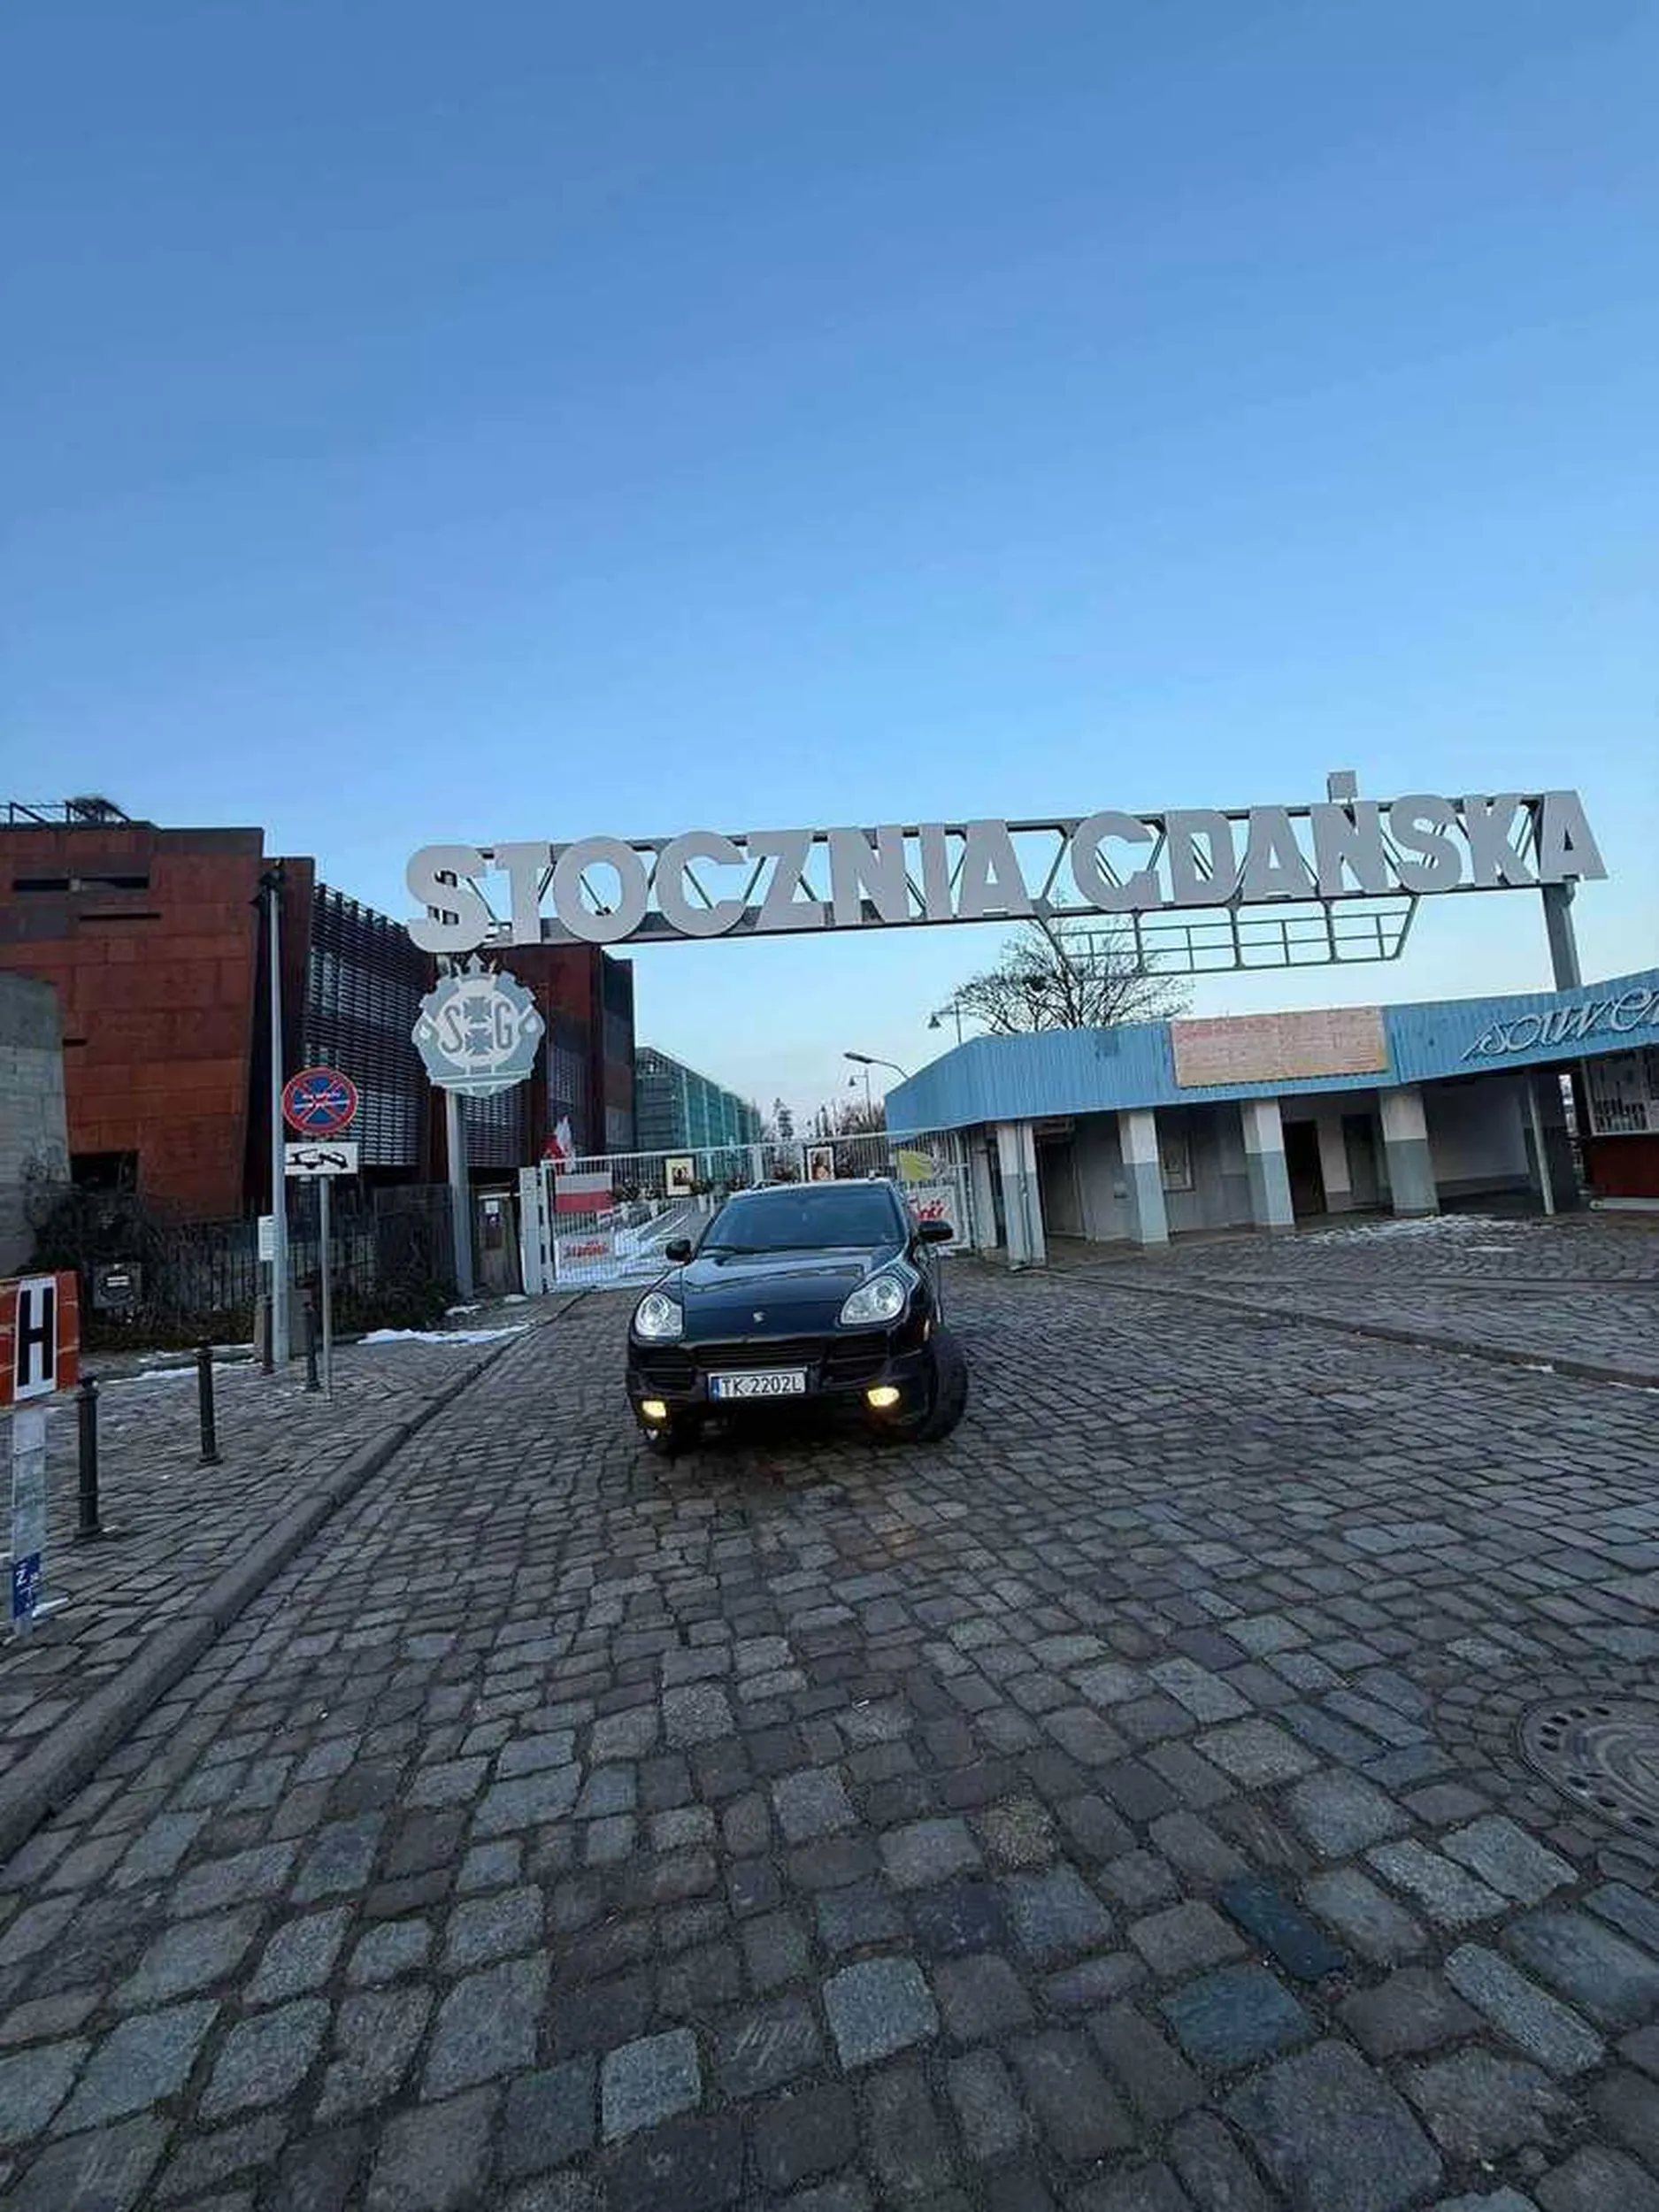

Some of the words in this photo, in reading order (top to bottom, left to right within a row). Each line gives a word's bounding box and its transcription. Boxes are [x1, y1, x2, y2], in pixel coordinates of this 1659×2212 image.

[405, 818, 1034, 954] STOCZNIA
[1070, 769, 1609, 914] GDAŃSKA
[17, 1286, 54, 1387] H
[721, 1379, 744, 1395] TK
[749, 1376, 803, 1394] 2202L
